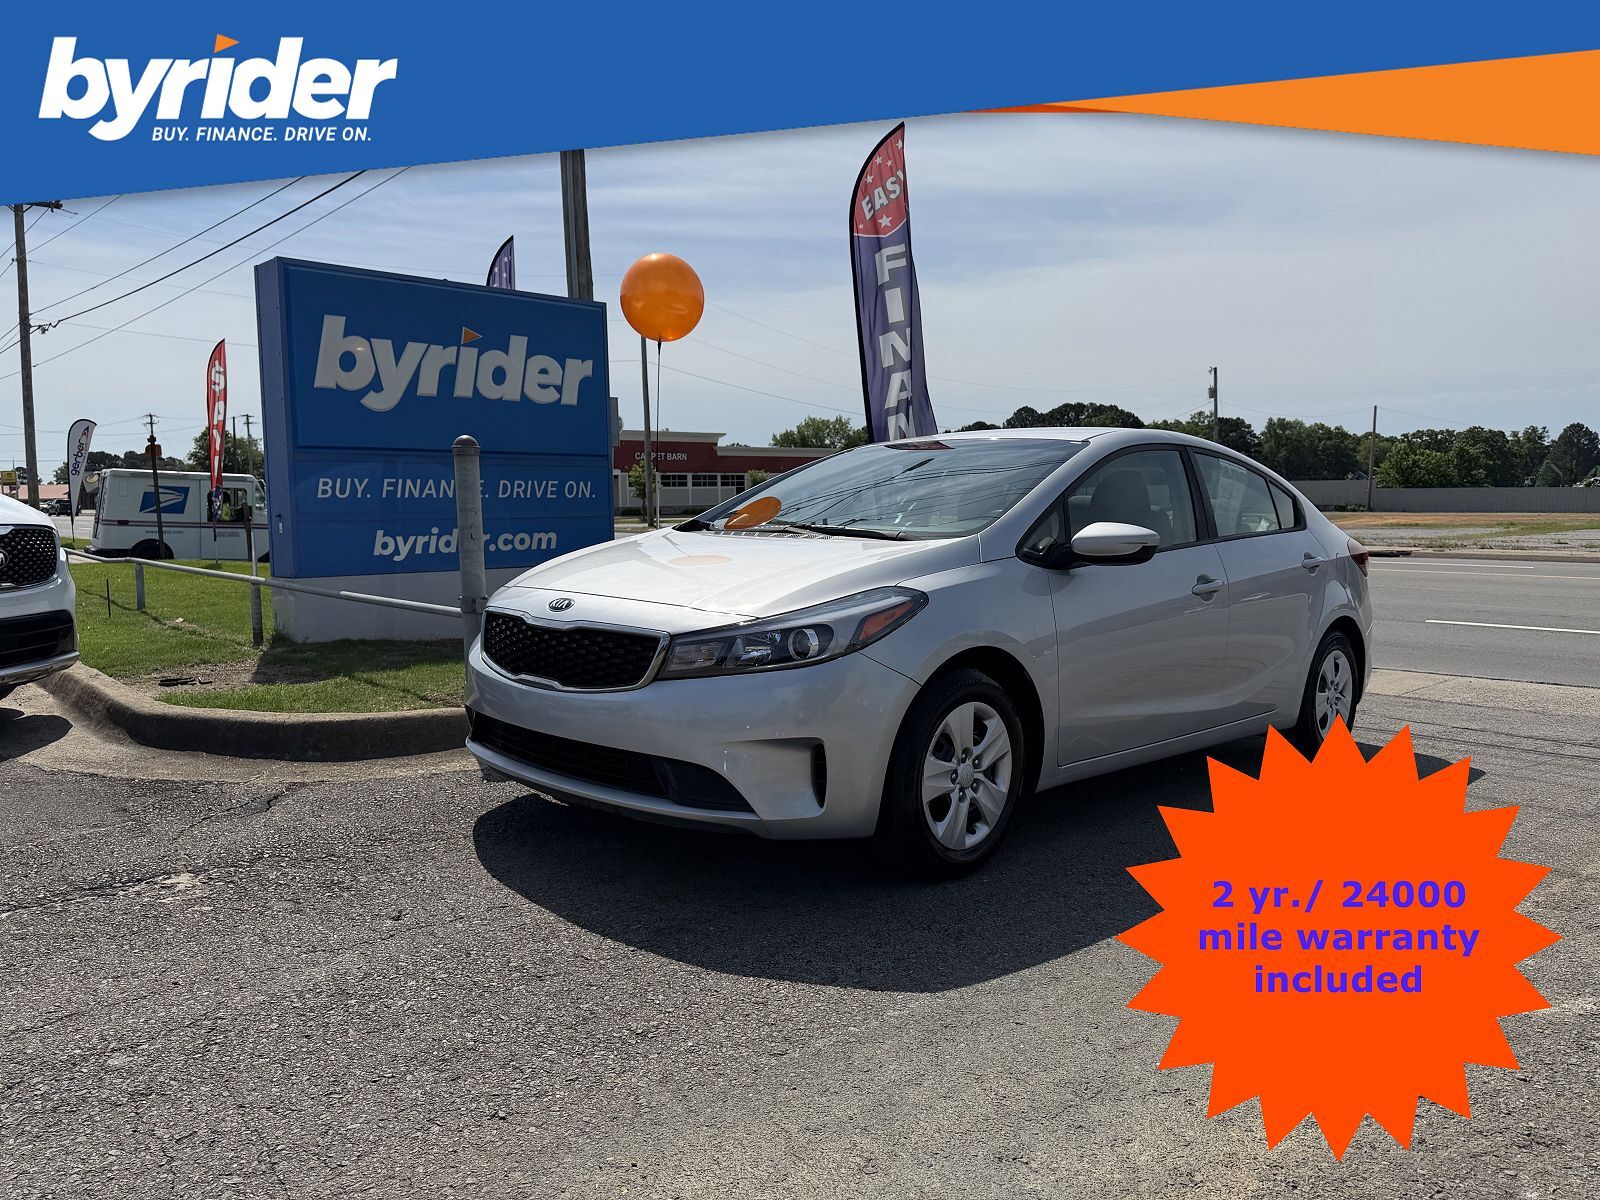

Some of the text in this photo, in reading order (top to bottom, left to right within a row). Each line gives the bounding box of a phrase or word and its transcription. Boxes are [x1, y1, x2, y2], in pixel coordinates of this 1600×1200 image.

[313, 314, 594, 412] byrider
[71, 438, 84, 476] gerber
[635, 452, 688, 461] CAPET BARN
[317, 477, 597, 499] BUY. FINAN. DRIVE ON.
[373, 526, 557, 562] byridr.com
